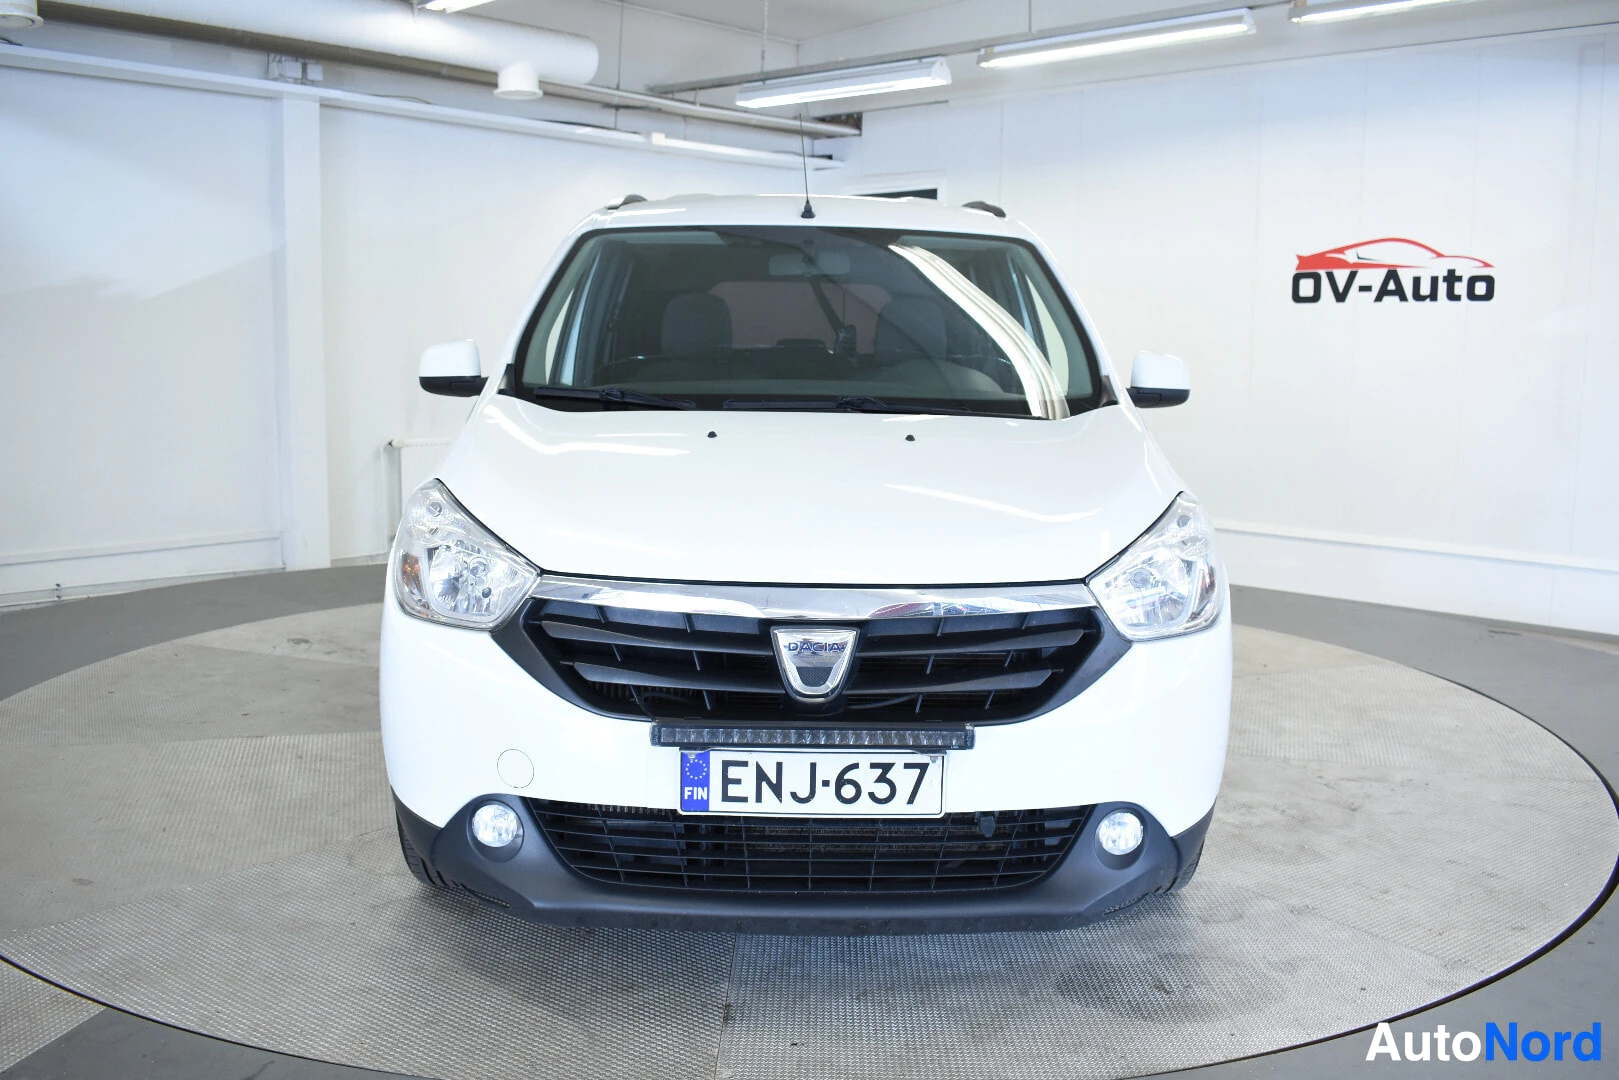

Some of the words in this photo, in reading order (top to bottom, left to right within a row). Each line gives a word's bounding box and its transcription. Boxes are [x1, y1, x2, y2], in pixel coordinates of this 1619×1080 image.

[1292, 269, 1495, 303] OV-Auto
[788, 642, 841, 652] DACIA
[684, 786, 707, 800] FIN
[721, 760, 930, 805] ENJ-637
